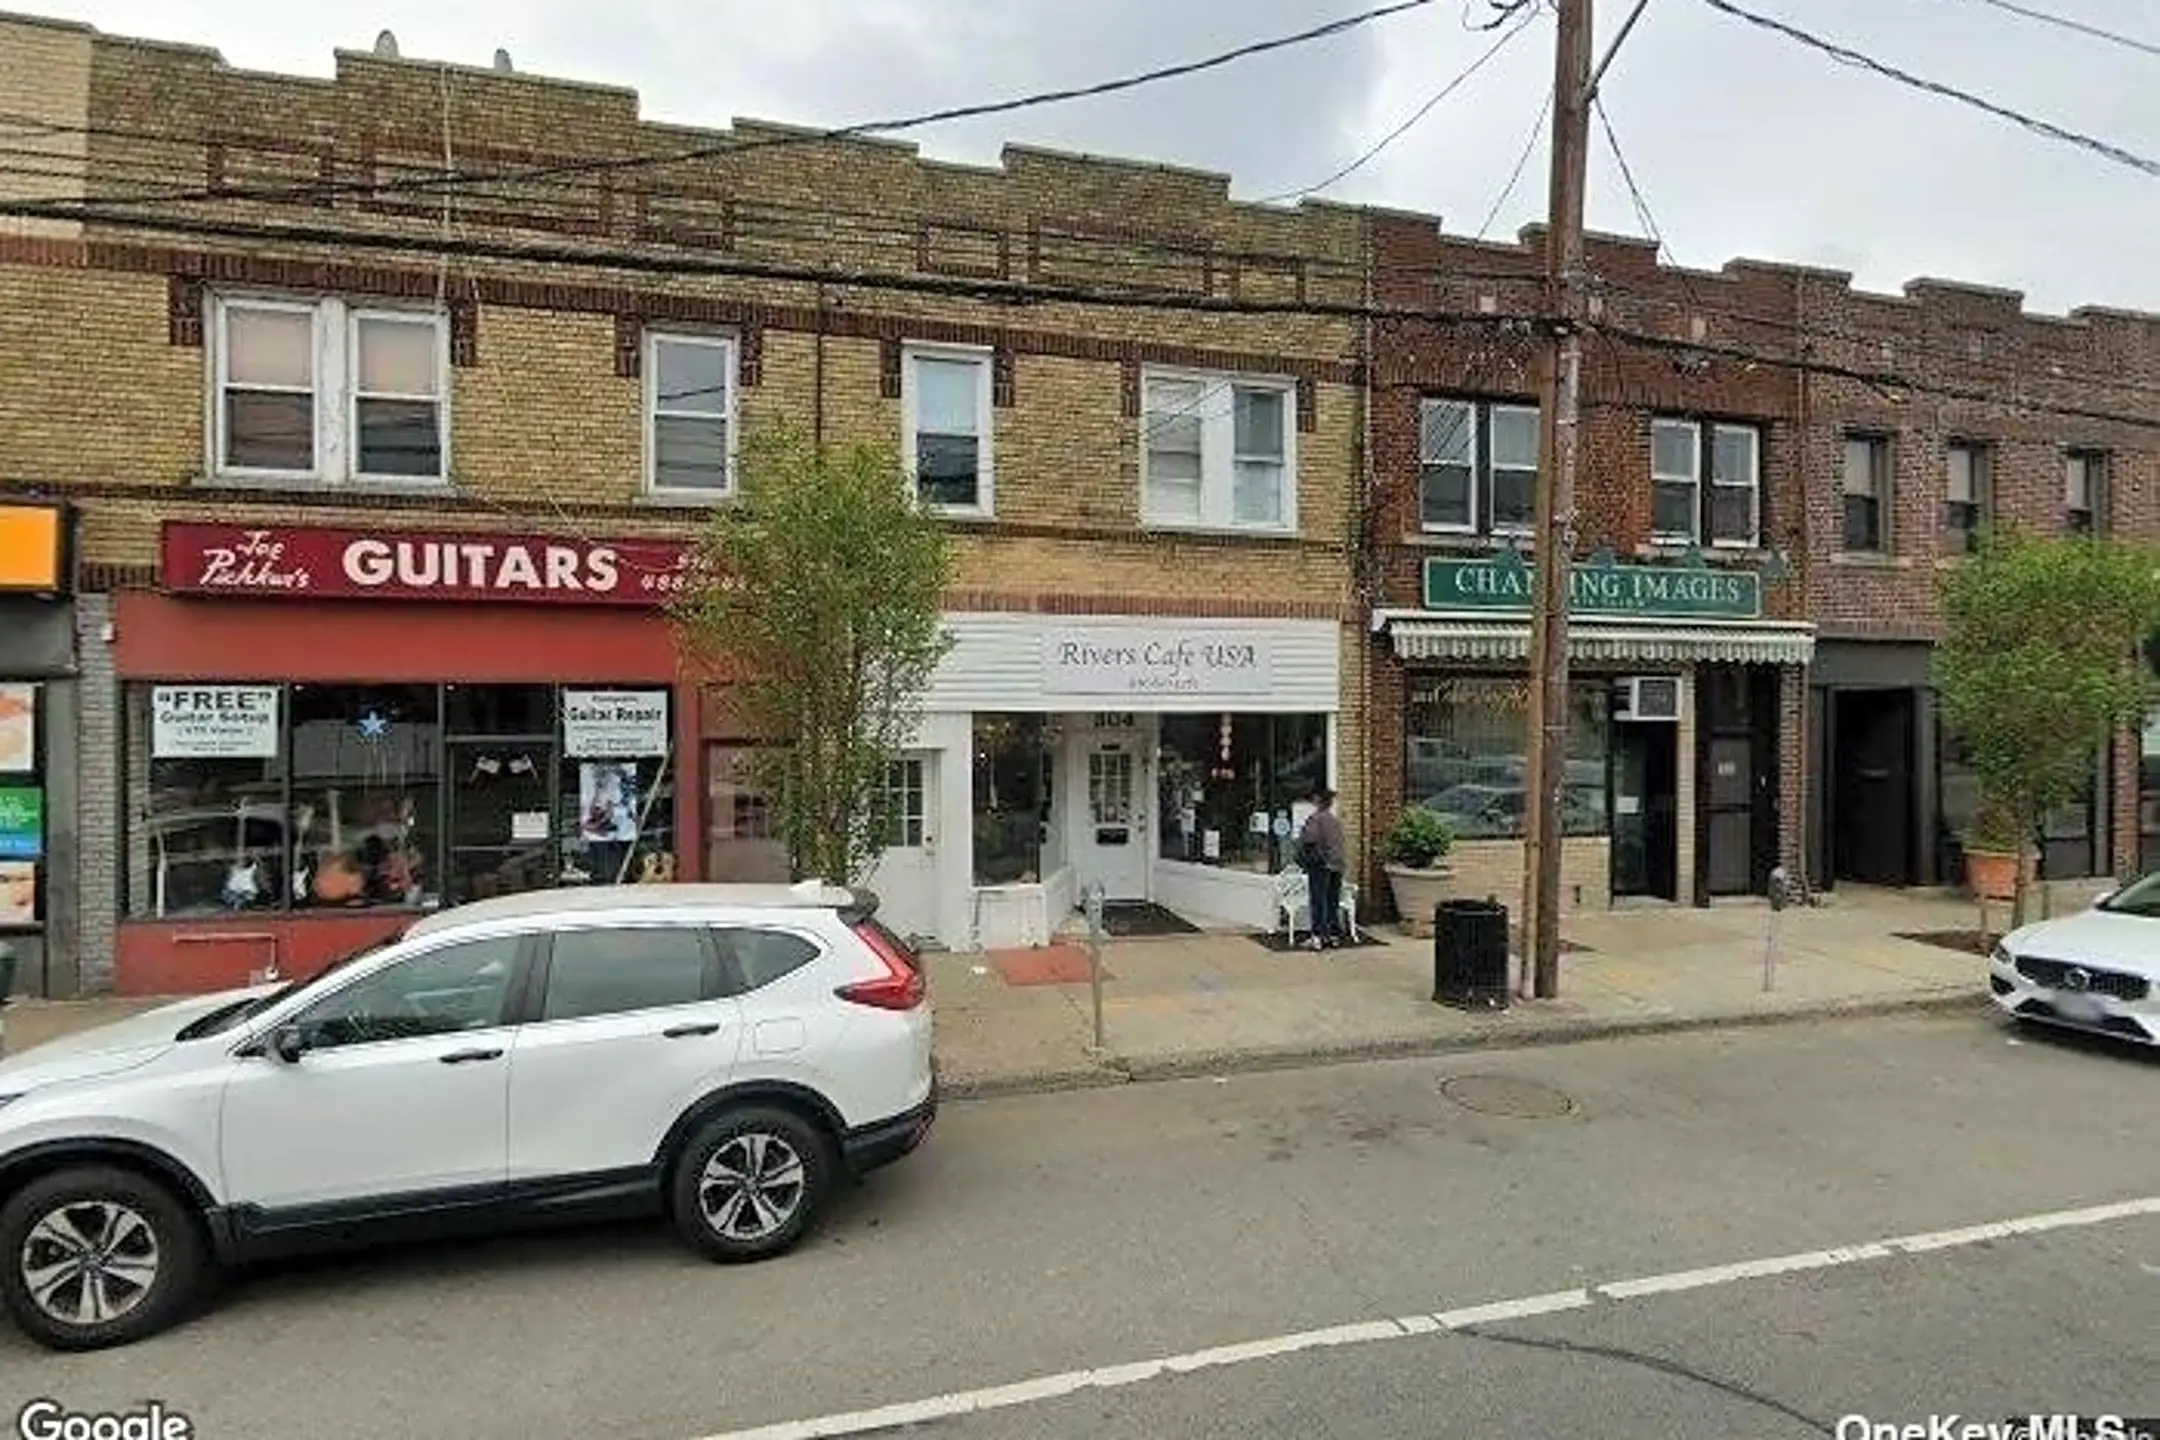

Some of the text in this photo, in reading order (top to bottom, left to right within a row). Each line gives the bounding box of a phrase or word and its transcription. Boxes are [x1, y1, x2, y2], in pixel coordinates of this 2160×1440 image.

[236, 531, 285, 560] Joe
[342, 539, 619, 592] GUITARS
[1633, 570, 1741, 602] IMAGES
[1060, 637, 1258, 677] Rivers Cafe USA
[160, 711, 213, 724] Guitar
[570, 707, 662, 723] Guitar Repair
